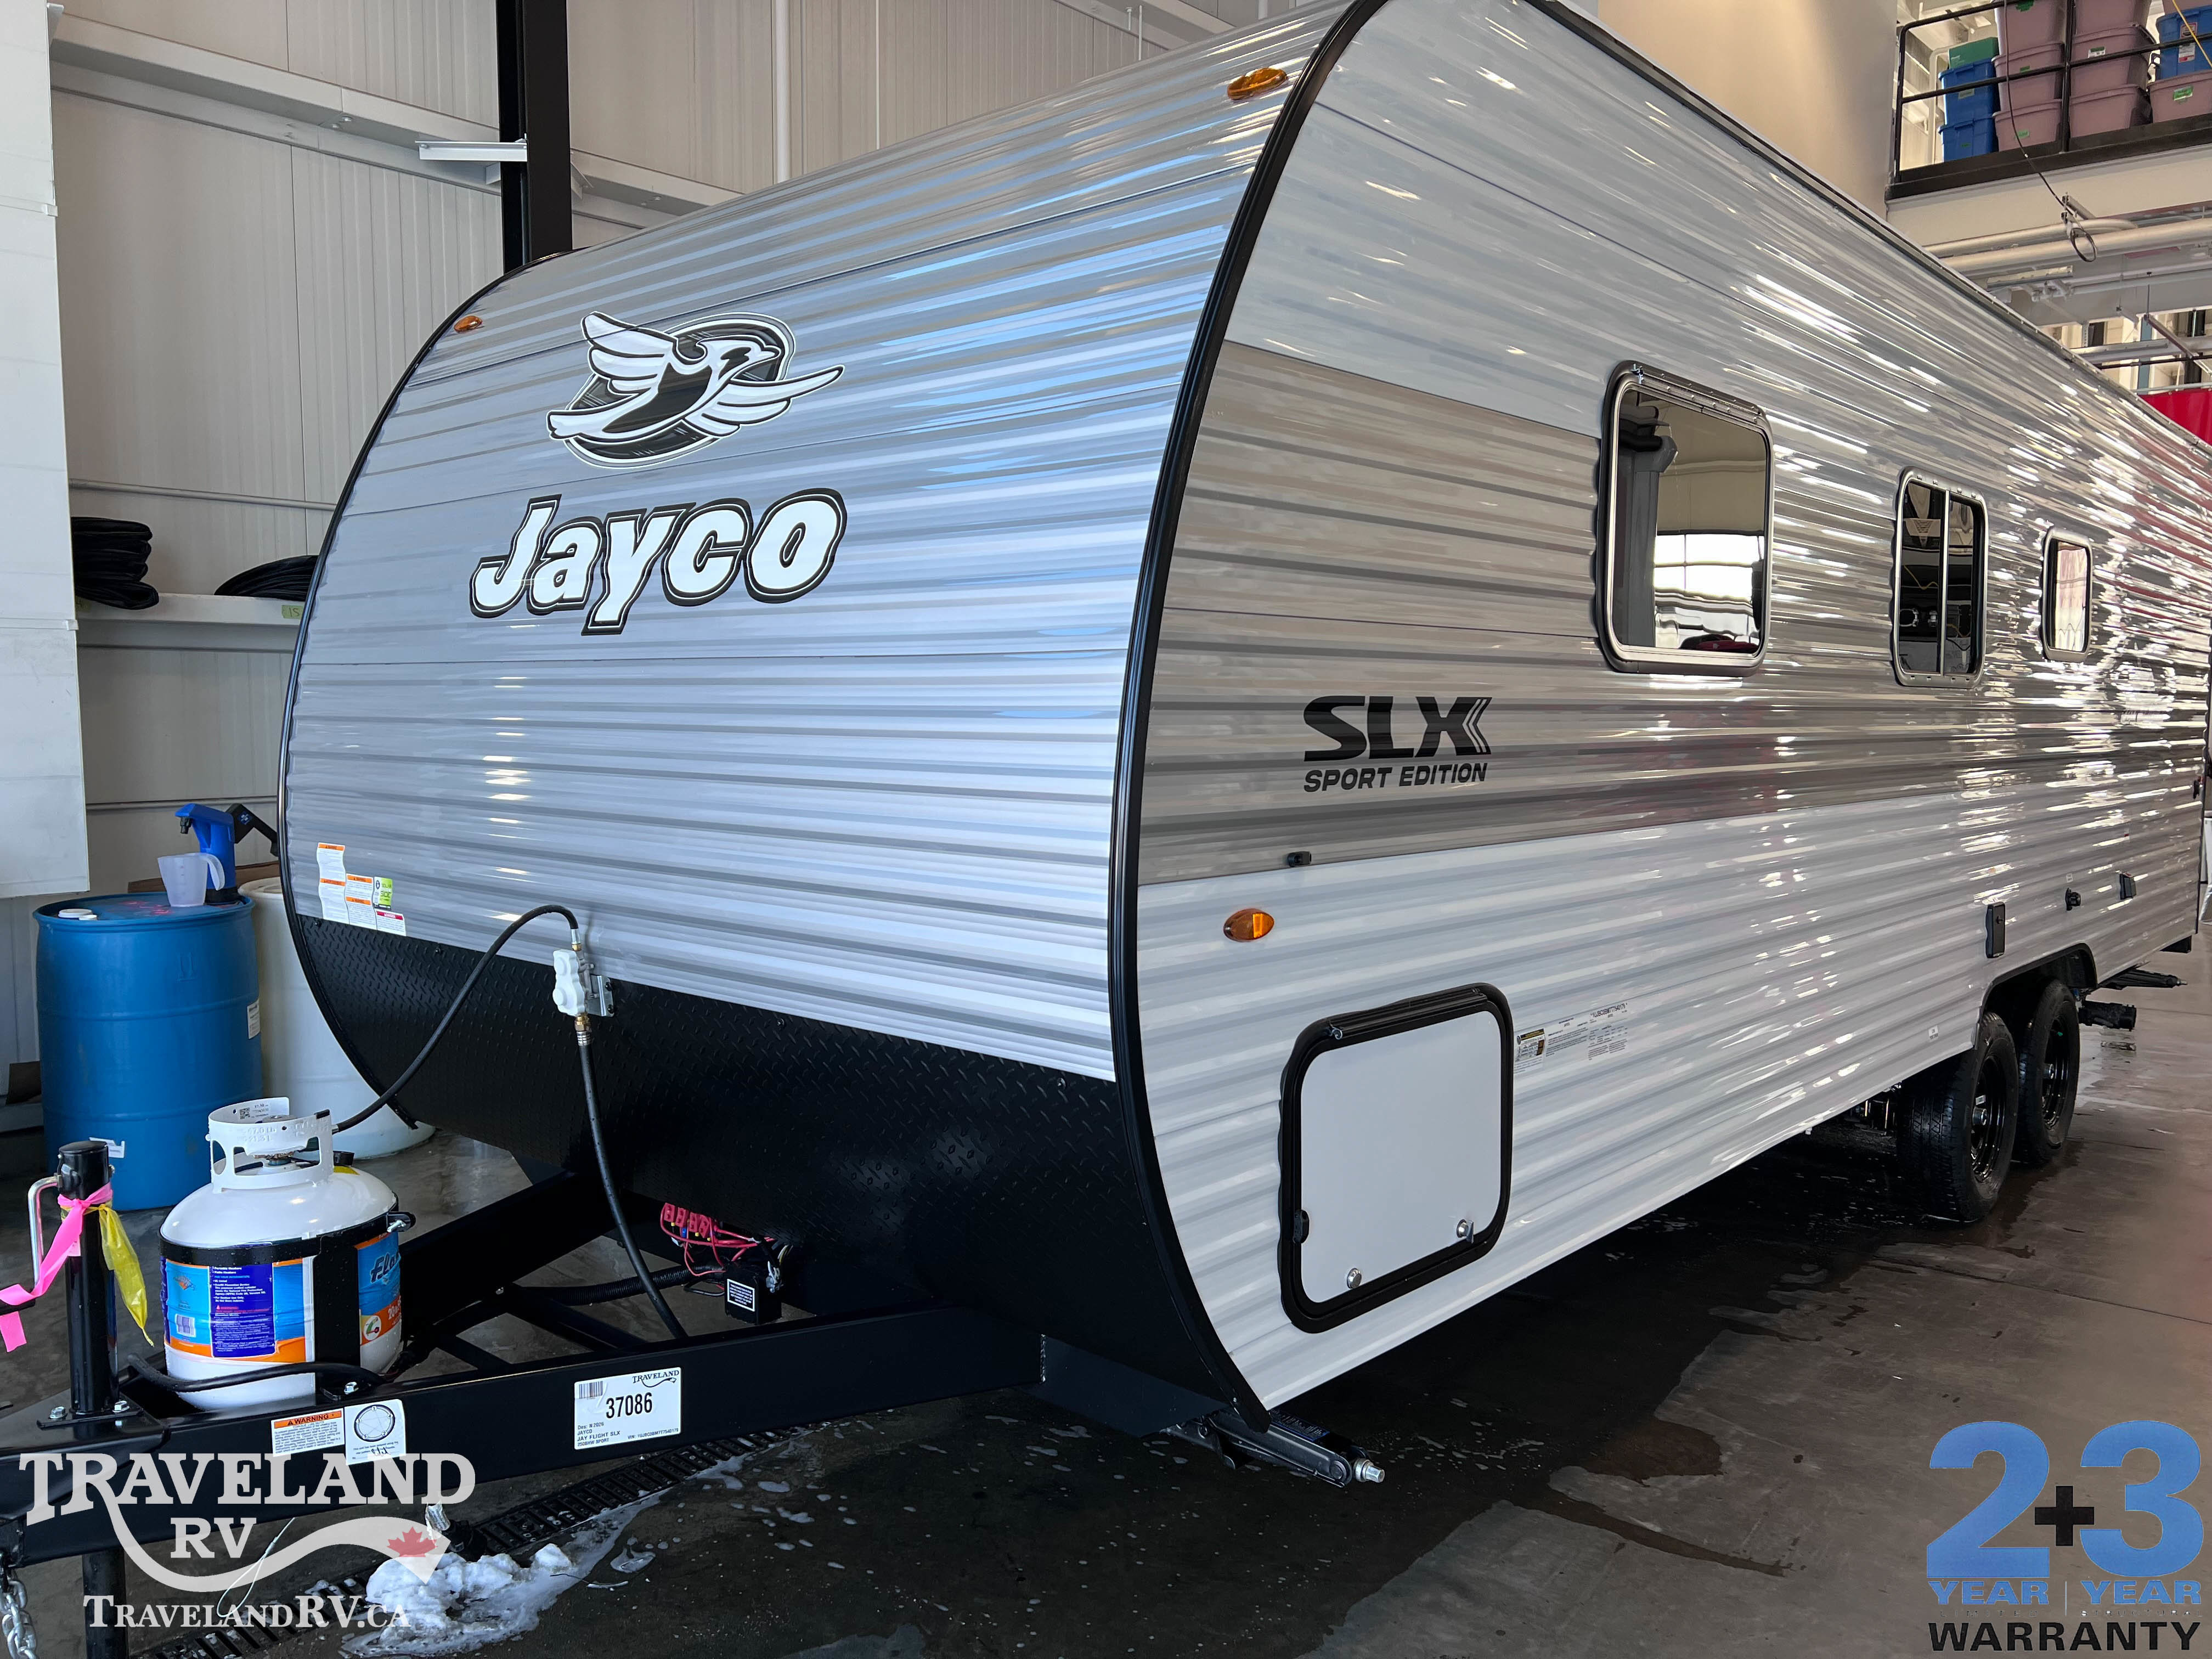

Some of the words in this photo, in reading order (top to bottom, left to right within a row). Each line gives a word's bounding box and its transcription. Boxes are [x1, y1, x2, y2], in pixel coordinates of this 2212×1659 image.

[469, 487, 848, 636] Jayco
[1303, 696, 1492, 761] SLX
[1304, 767, 1392, 792] SPORT
[1399, 763, 1487, 787] EDITION
[633, 1370, 680, 1384] TRAVELAND
[295, 1414, 329, 1425] WARNING
[606, 1392, 652, 1419] 37086
